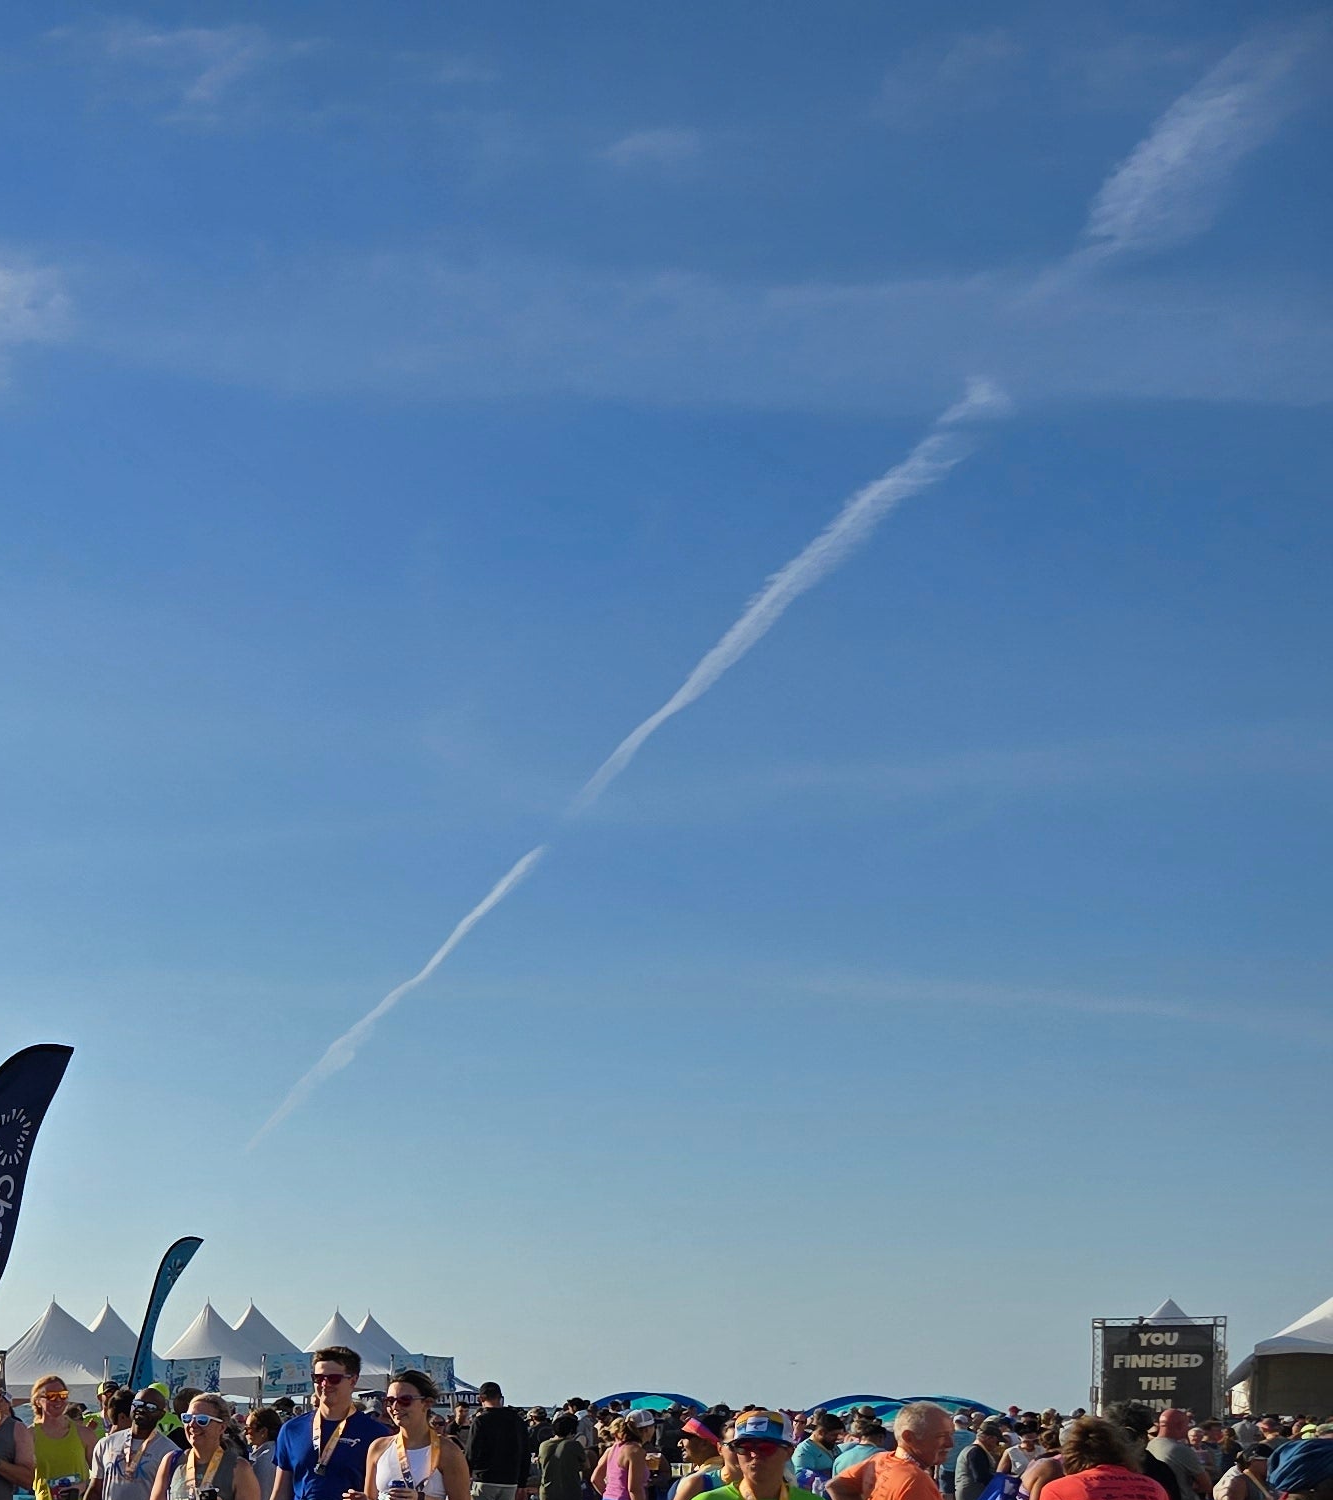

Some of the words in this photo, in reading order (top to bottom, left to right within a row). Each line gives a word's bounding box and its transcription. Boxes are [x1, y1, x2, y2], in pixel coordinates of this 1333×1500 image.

[1138, 1331, 1179, 1346] YOU
[1113, 1353, 1204, 1369] FINISHED
[1138, 1376, 1177, 1391] THE
